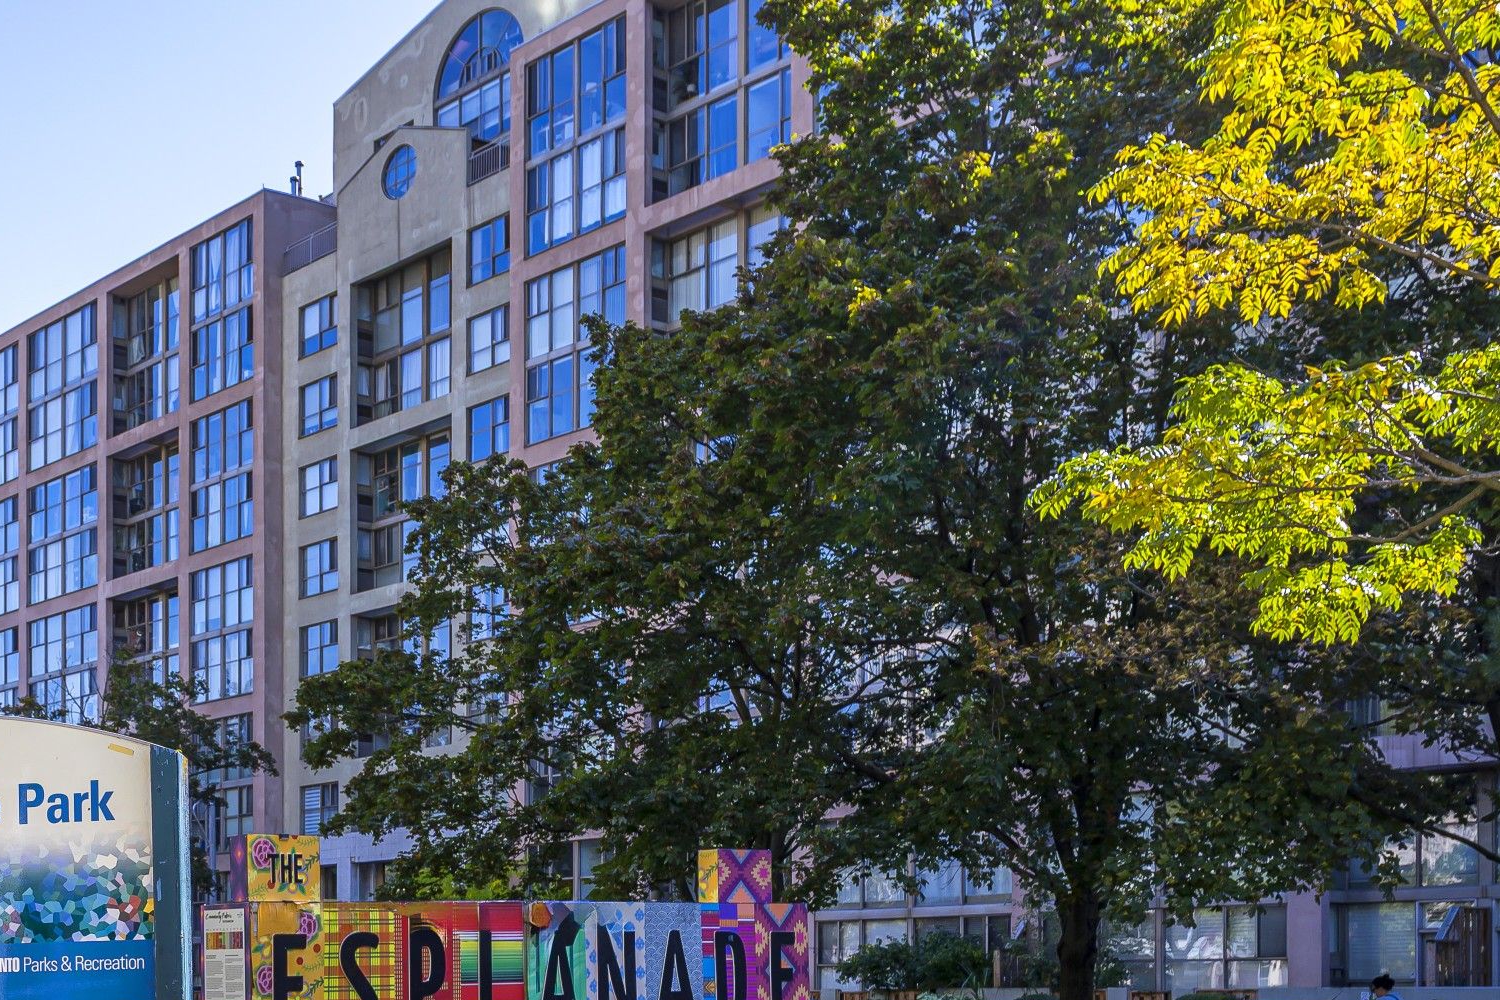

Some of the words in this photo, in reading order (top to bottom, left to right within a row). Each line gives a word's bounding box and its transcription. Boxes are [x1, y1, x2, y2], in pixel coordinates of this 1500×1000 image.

[18, 780, 116, 825] Park
[266, 852, 304, 884] THE
[23, 956, 58, 973] Parks
[61, 955, 73, 972] &
[75, 954, 145, 972] Recreation
